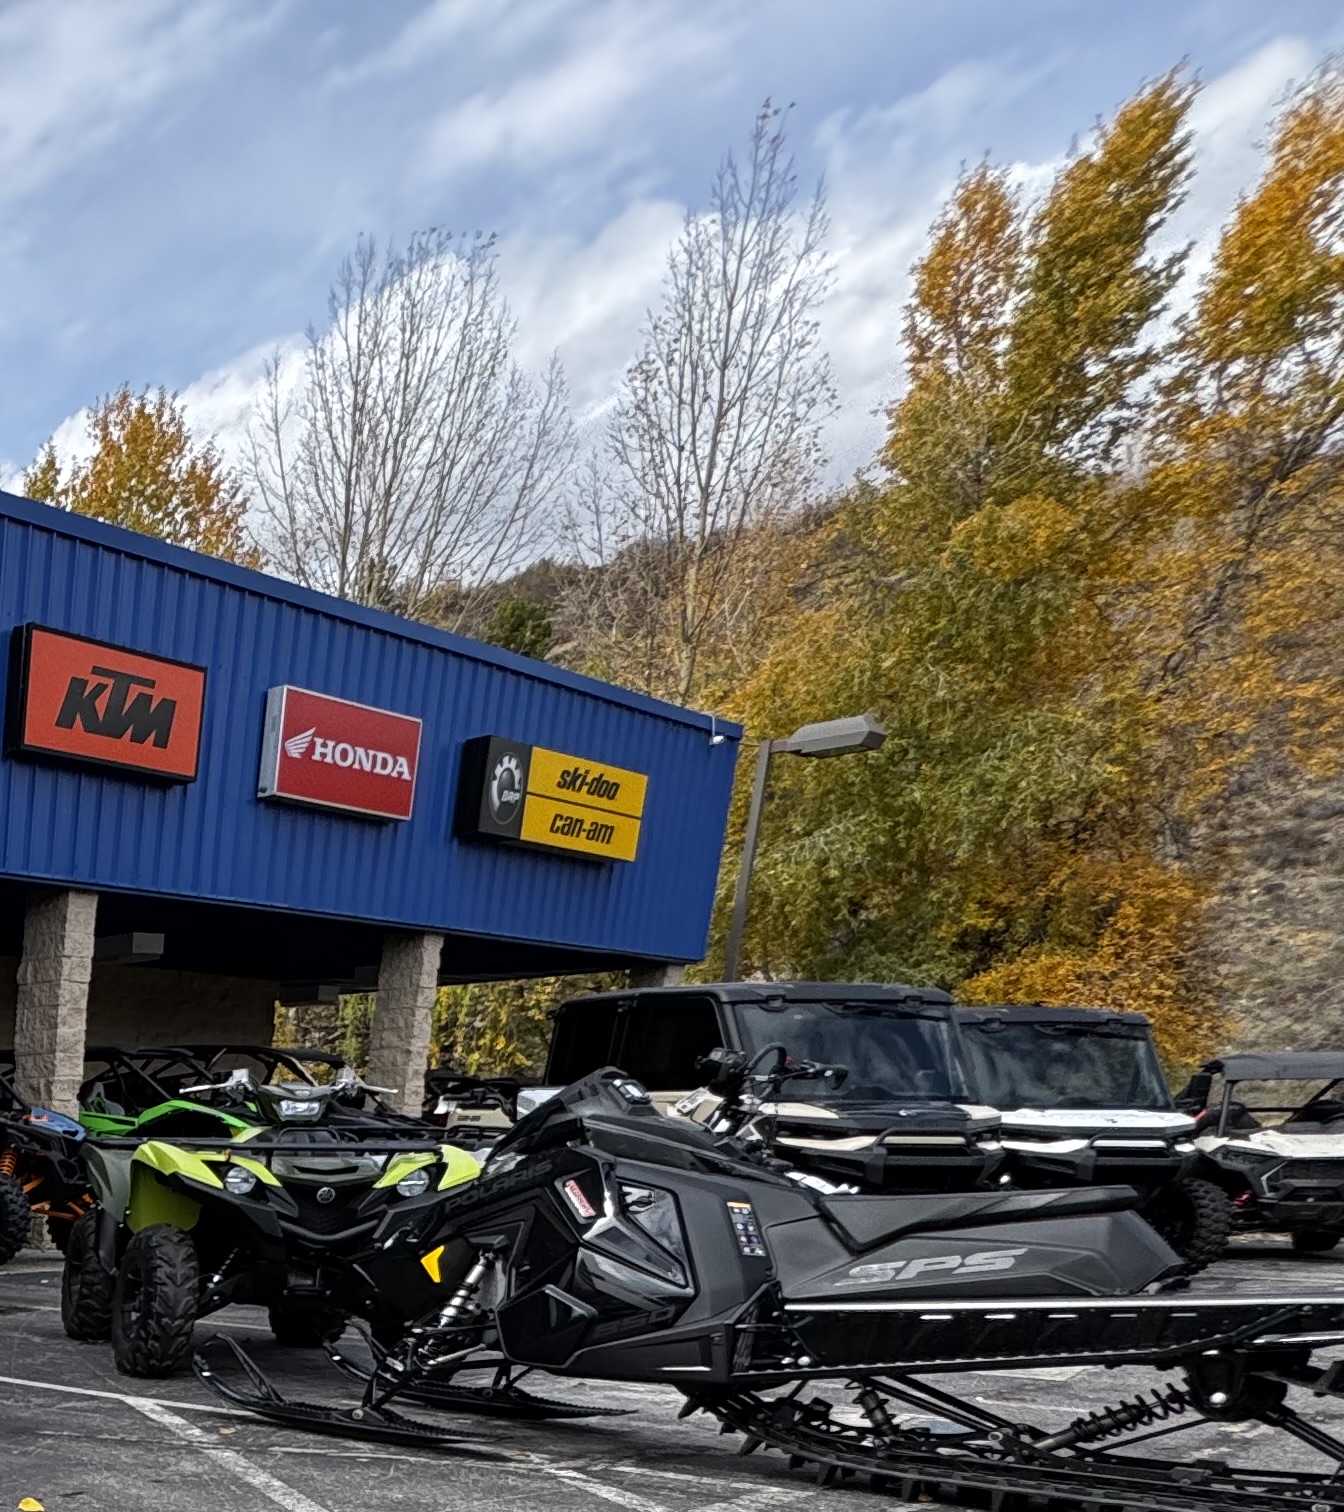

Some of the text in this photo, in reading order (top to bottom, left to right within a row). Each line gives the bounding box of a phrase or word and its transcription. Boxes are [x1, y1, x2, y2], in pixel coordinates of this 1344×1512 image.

[55, 665, 177, 749] KTM
[311, 737, 412, 781] HONDA
[556, 767, 621, 801] ski-doo
[550, 813, 614, 845] can-am
[444, 1159, 553, 1214] POLARIS
[833, 1248, 1029, 1287] SPS
